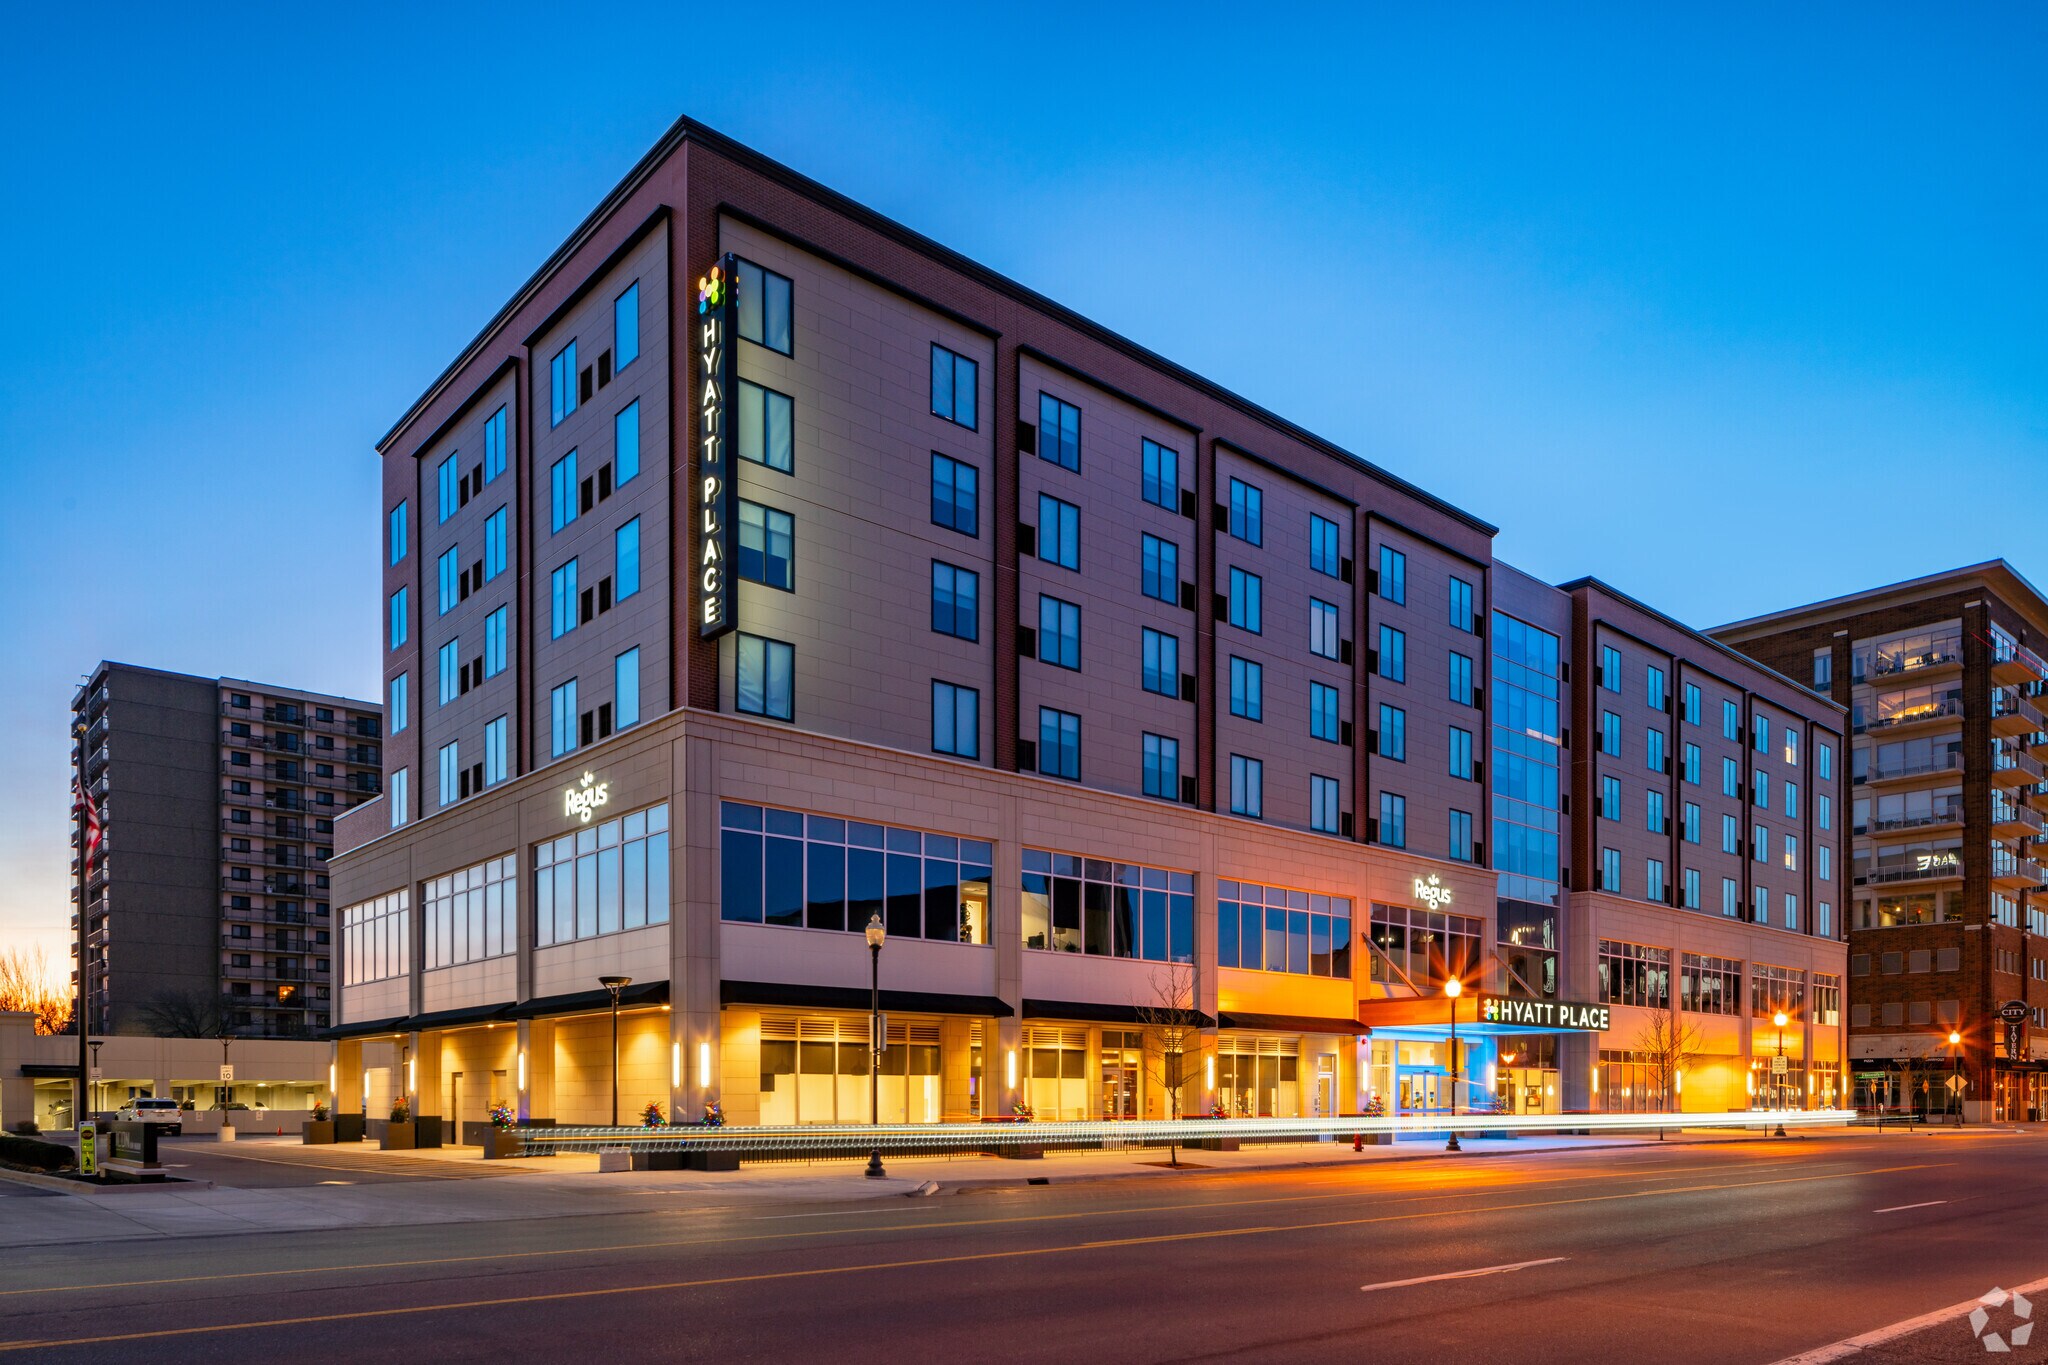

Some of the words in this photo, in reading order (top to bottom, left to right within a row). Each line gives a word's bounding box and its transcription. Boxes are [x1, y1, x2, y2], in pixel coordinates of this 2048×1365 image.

[703, 318, 721, 464] HYATT
[703, 476, 722, 625] PLACE
[565, 783, 608, 823] Regus
[1414, 878, 1451, 910] Regus
[1501, 1000, 1554, 1024] HYATT
[1560, 1005, 1609, 1029] PLACE
